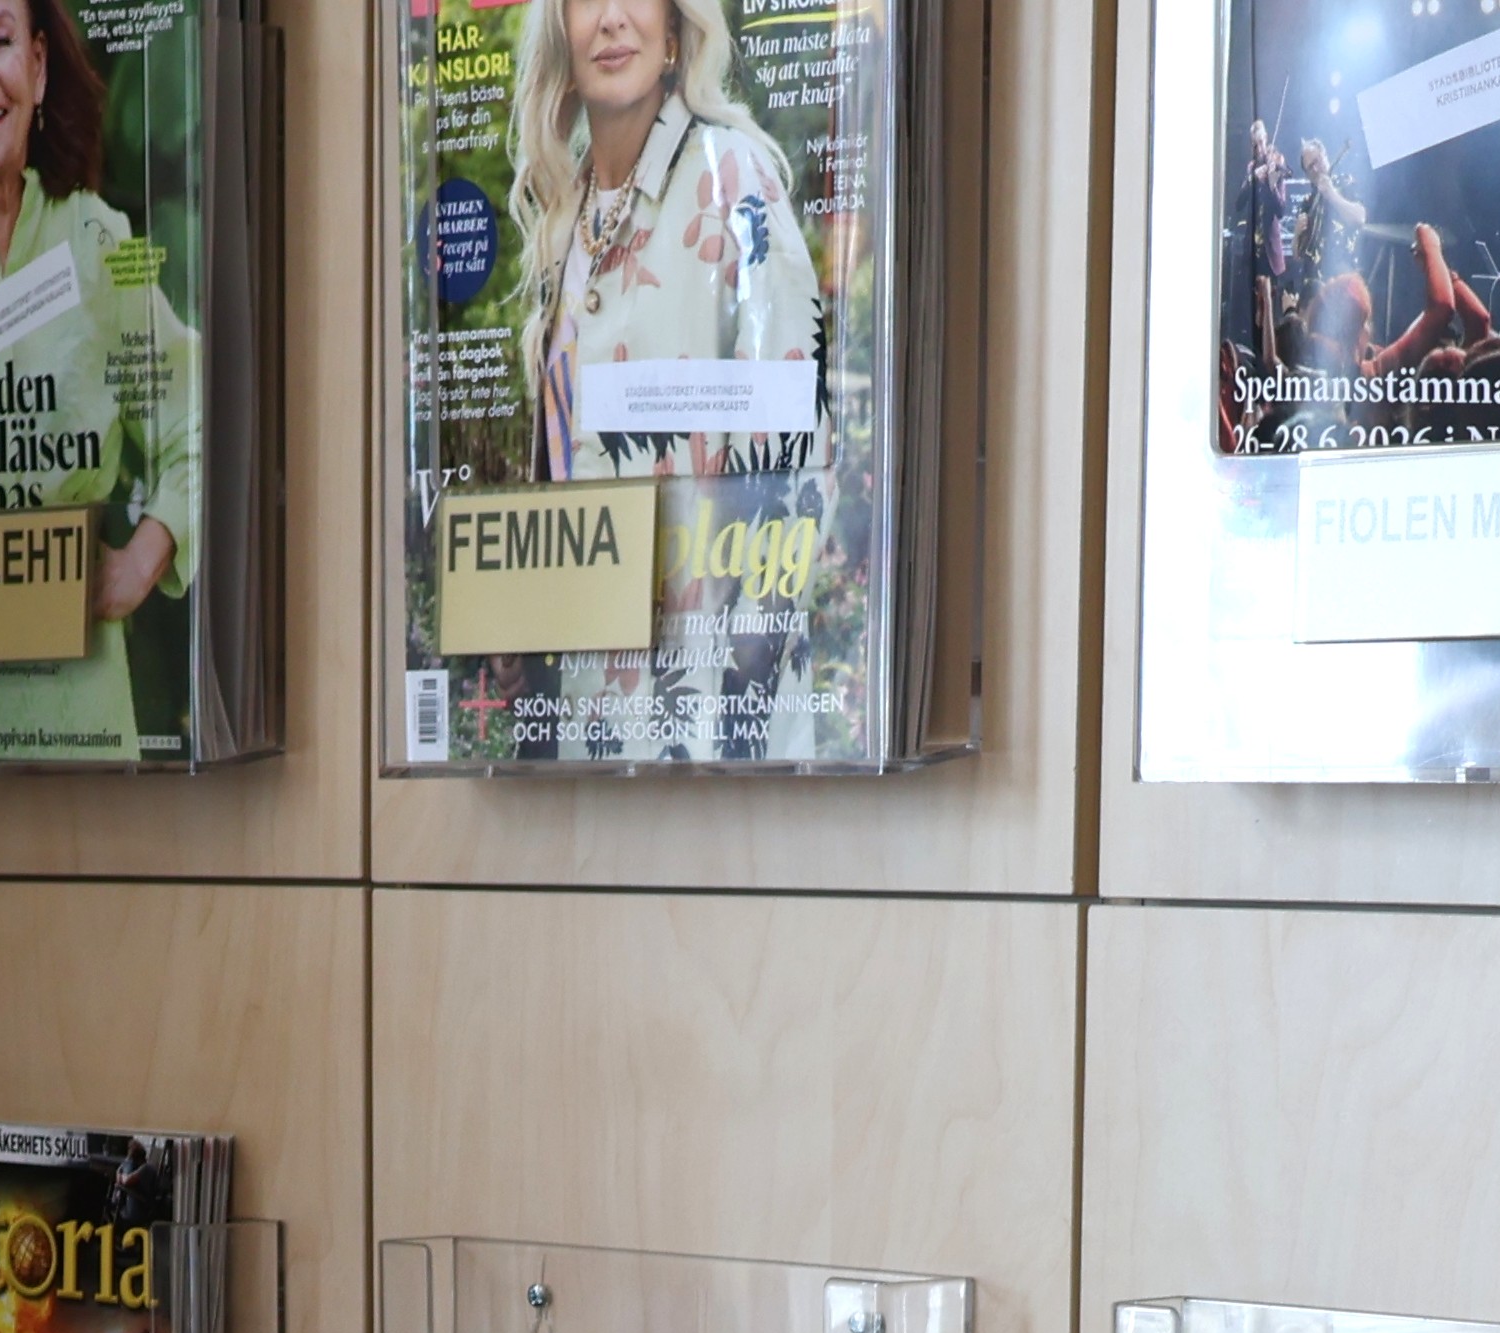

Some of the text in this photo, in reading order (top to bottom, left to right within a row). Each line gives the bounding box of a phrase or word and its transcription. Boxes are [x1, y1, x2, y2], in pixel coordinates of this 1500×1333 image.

[438, 21, 484, 53] HÅR-
[1315, 494, 1456, 543] FIOLEN
[449, 507, 619, 572] FEMINA
[514, 690, 844, 719] SKÖNA SNEAKERS, SKJORTKLÄNNINGEN
[514, 716, 770, 741] OCH SOLGLASÖGON TILL MAX
